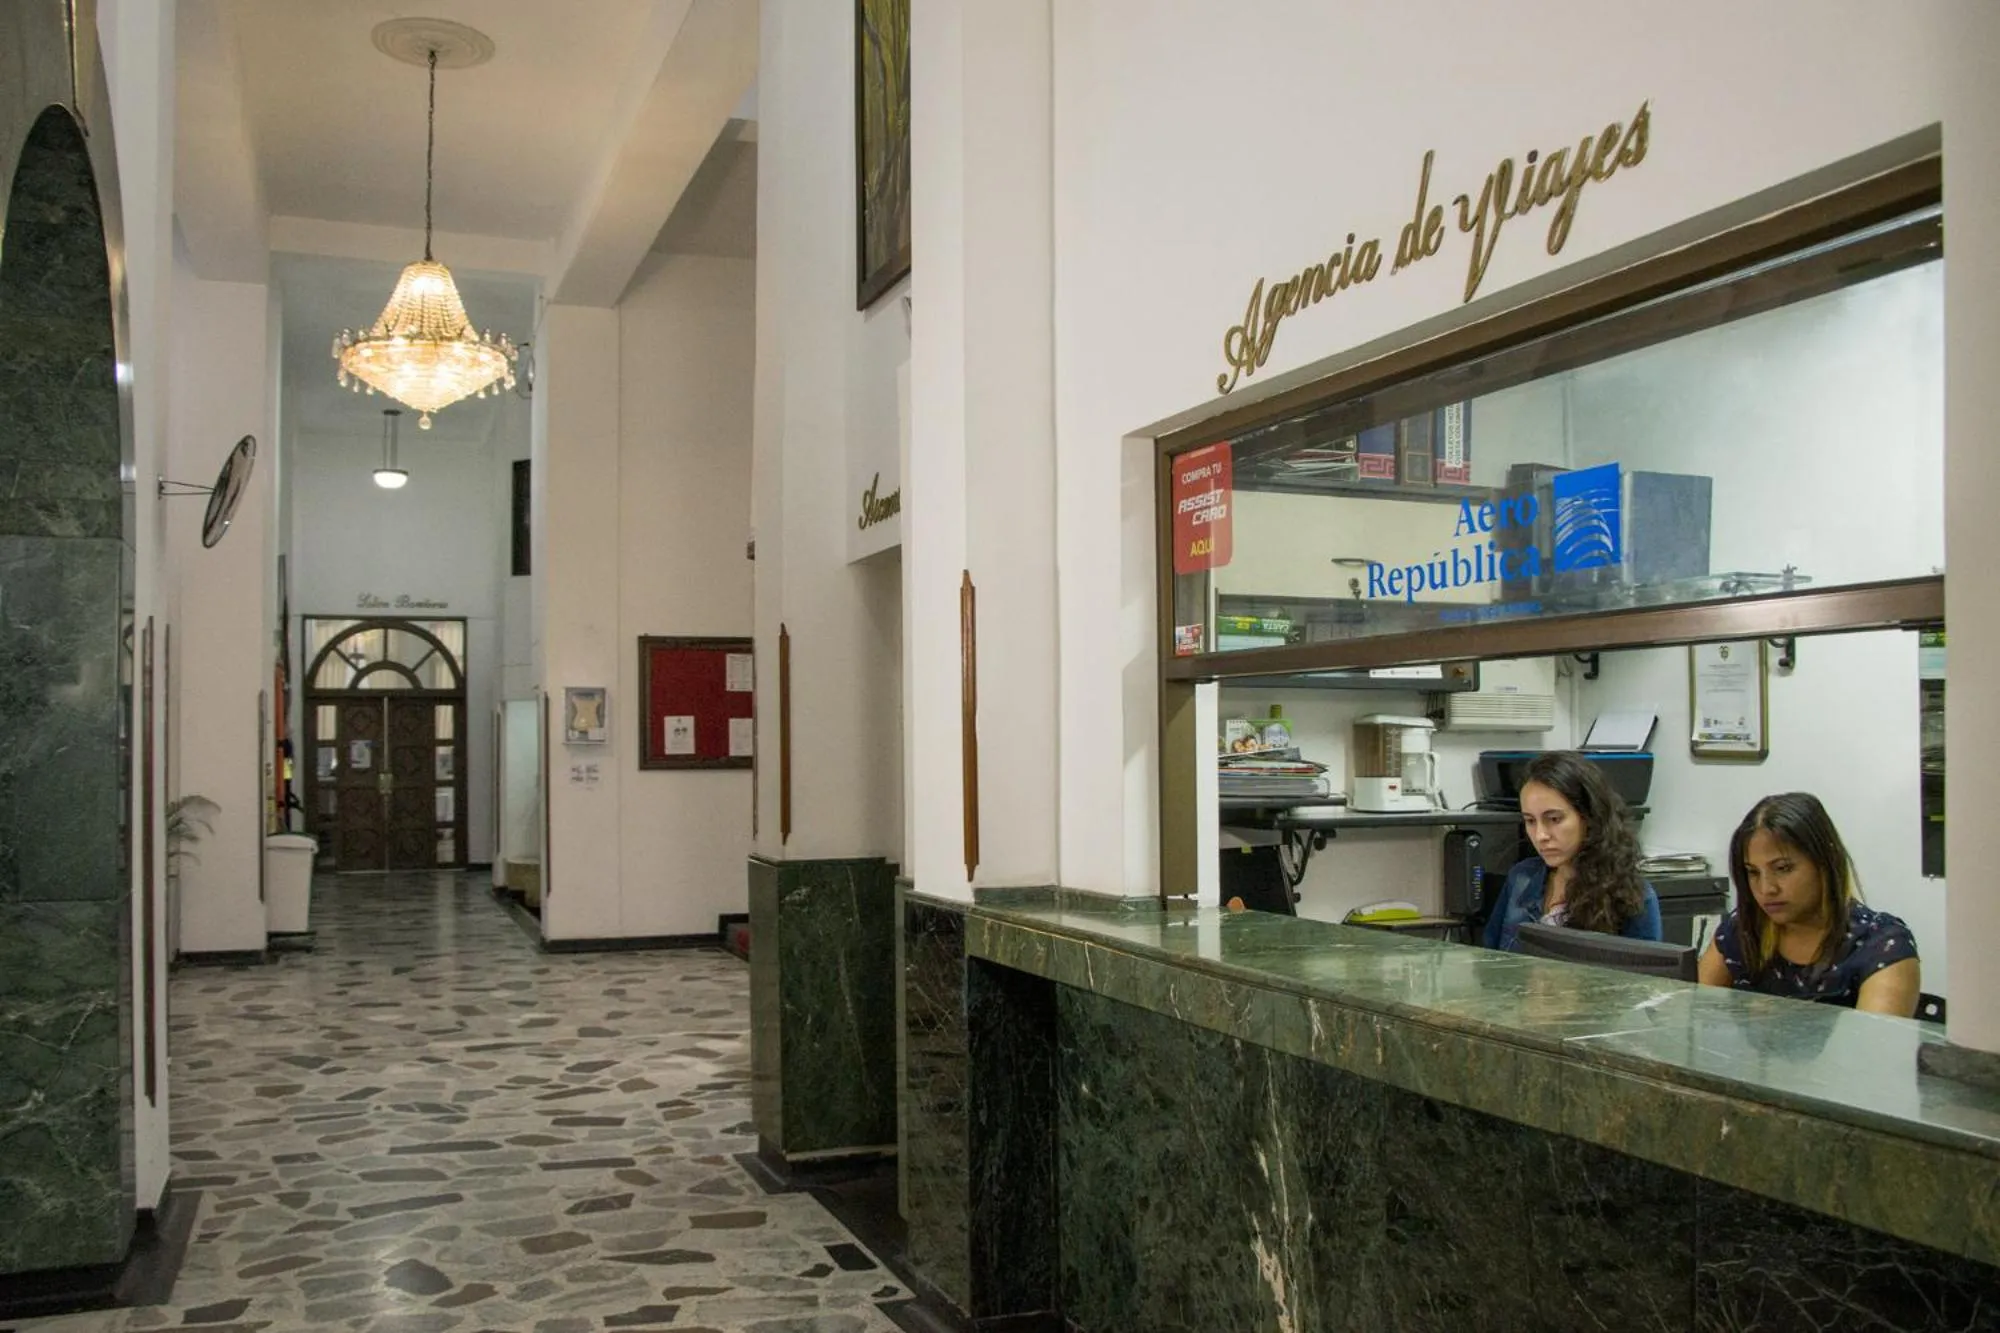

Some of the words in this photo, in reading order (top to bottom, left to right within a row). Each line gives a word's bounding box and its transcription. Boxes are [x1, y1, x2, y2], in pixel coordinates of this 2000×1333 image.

[1217, 232, 1382, 394] Agencia
[1391, 149, 1445, 275] de
[1452, 98, 1651, 303] Viajes
[1181, 466, 1211, 485] COMPRA
[1212, 461, 1222, 477] TU
[1178, 489, 1225, 515] ASSIST
[1192, 503, 1228, 526] CARD
[1453, 490, 1541, 537] Aero
[1368, 540, 1542, 605] República
